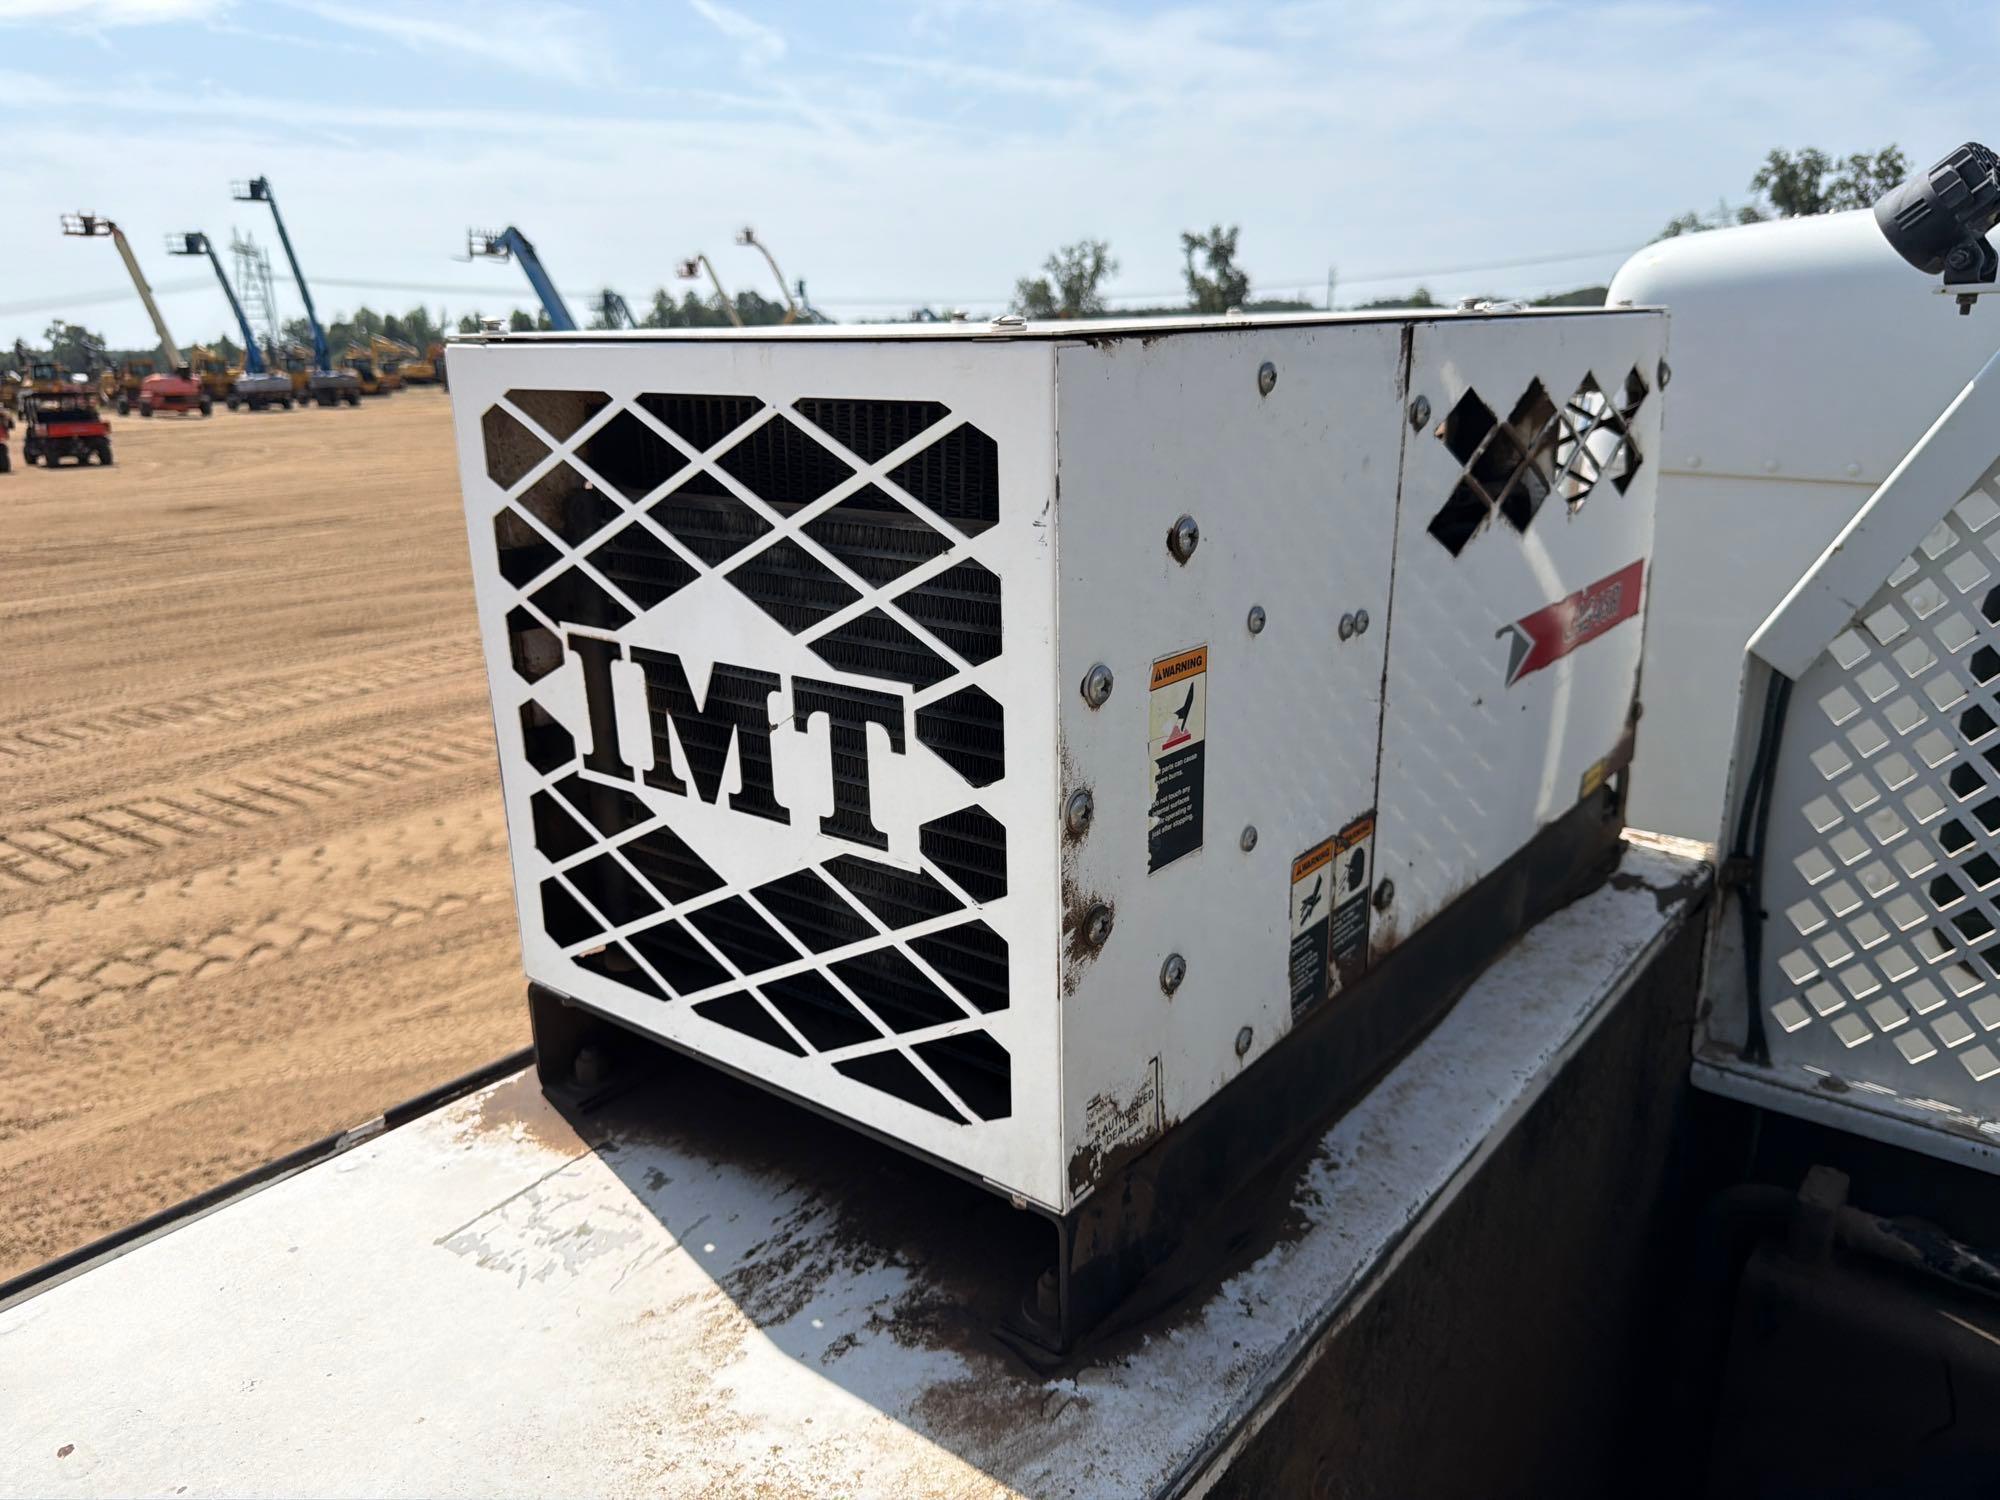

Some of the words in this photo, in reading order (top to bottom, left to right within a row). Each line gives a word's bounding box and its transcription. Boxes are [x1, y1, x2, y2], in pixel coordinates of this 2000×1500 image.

[1163, 656, 1203, 678] WARNING
[568, 633, 905, 851] IMT
[1169, 789, 1181, 800] touch
[1106, 1112, 1139, 1145] DEALER
